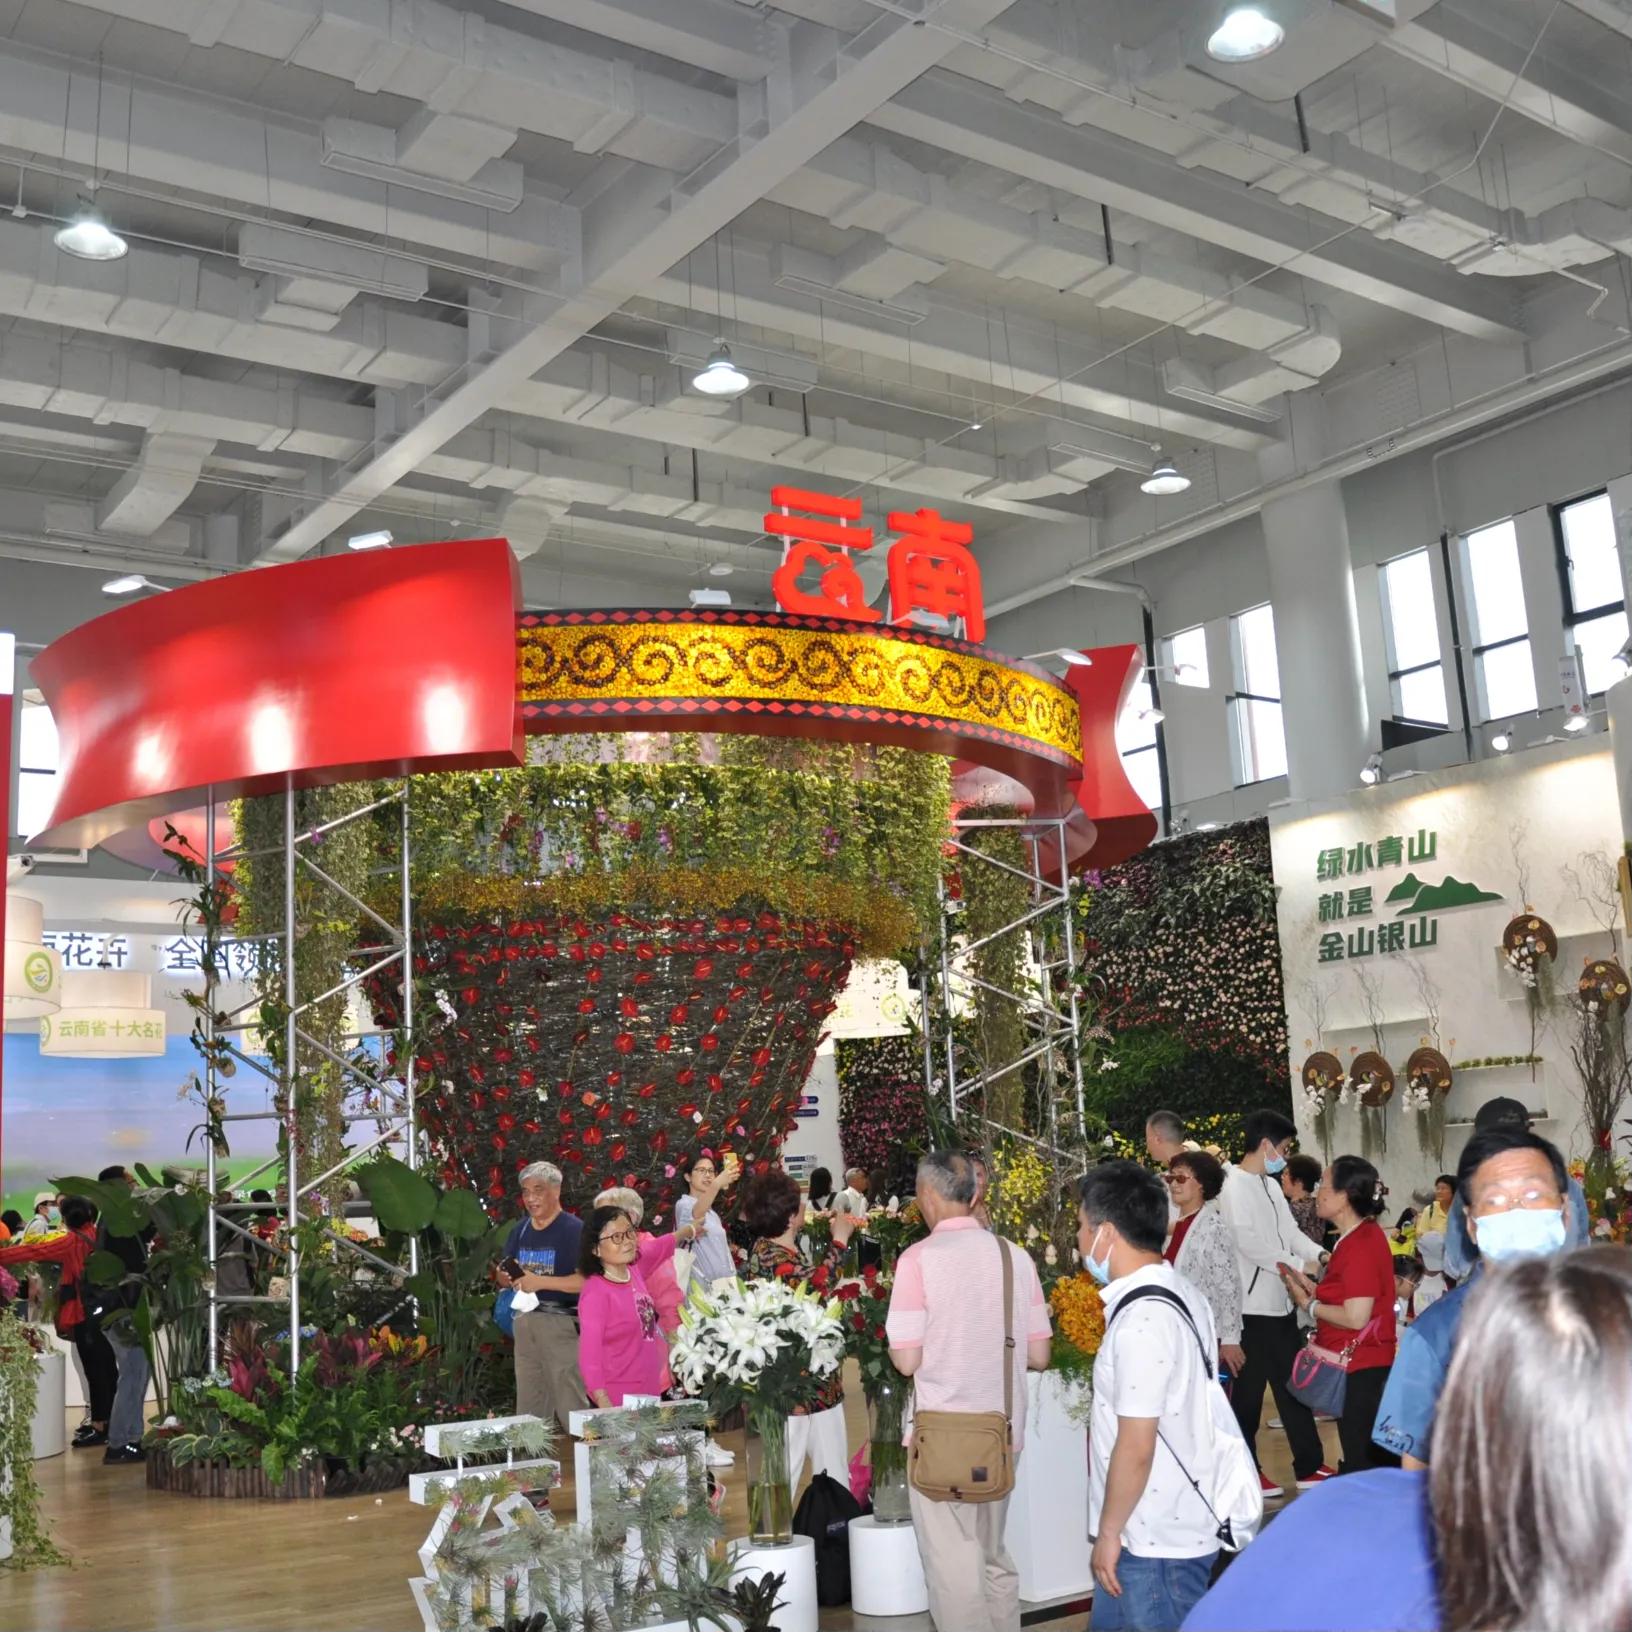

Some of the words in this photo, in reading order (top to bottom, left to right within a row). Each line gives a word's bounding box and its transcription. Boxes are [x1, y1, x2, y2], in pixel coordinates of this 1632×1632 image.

[763, 484, 987, 645] 云南
[1316, 829, 1439, 881] 绿水青山
[1317, 886, 1374, 922] 就是
[1317, 916, 1439, 964] 金山银山
